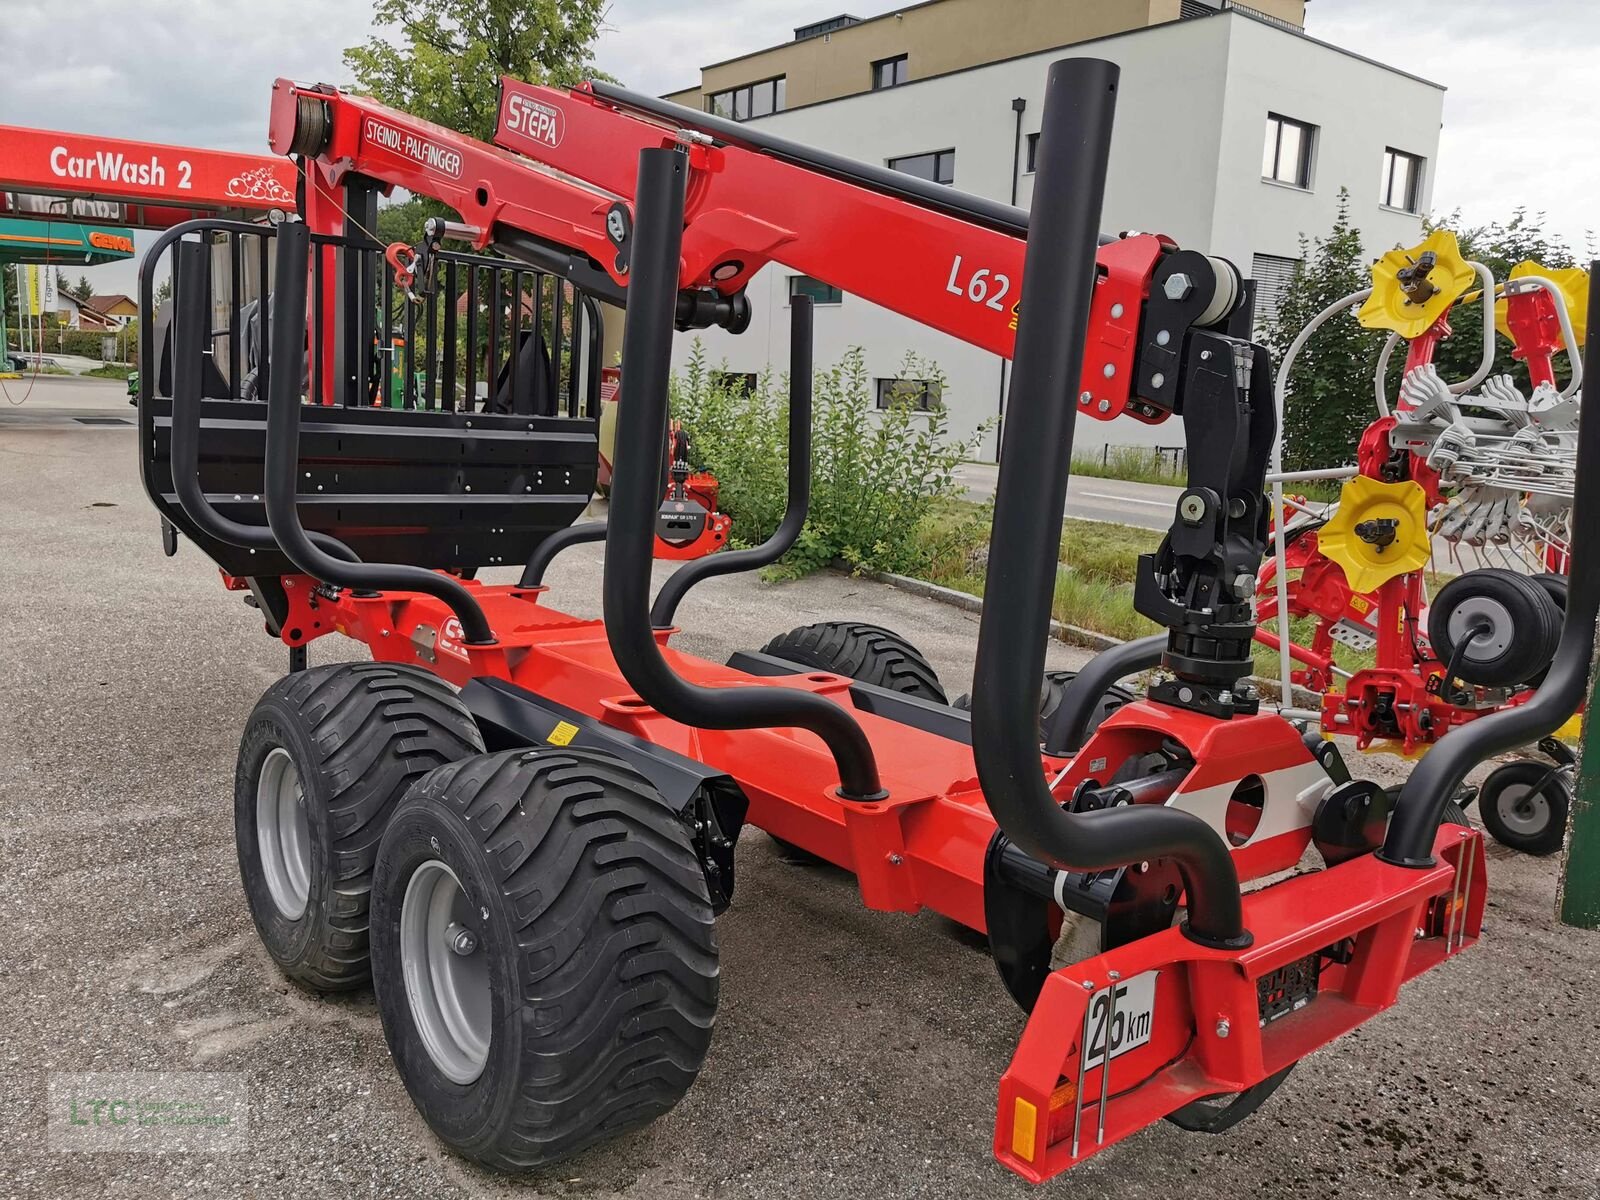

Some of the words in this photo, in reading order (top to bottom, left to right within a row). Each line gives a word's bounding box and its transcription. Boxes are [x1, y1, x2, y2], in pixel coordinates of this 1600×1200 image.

[507, 95, 556, 145] STEPA
[50, 146, 165, 187] CarWash
[178, 160, 192, 189] 2
[366, 121, 460, 176] STEINDL-PALFINGER
[1087, 986, 1127, 1061] 25
[1126, 1010, 1151, 1043] km
